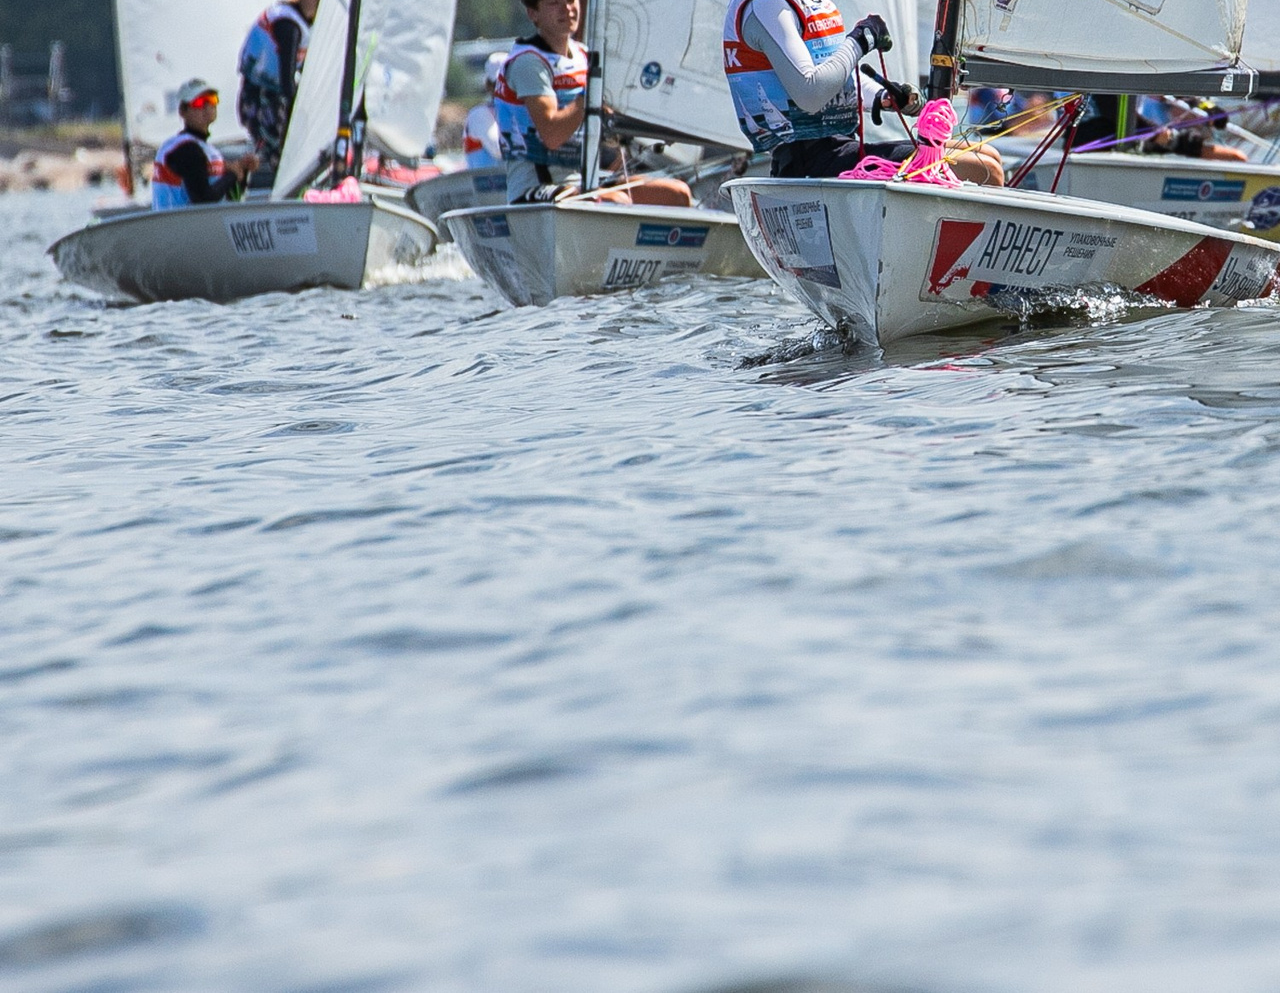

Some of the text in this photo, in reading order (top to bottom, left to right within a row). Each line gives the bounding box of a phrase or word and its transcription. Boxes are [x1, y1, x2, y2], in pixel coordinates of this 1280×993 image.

[229, 217, 275, 253] АРНЕСТ
[977, 219, 1118, 276] АРНЕСТ УПАКОВОЧНЫЕ
[1063, 246, 1096, 260] РЕШЕНИЯ
